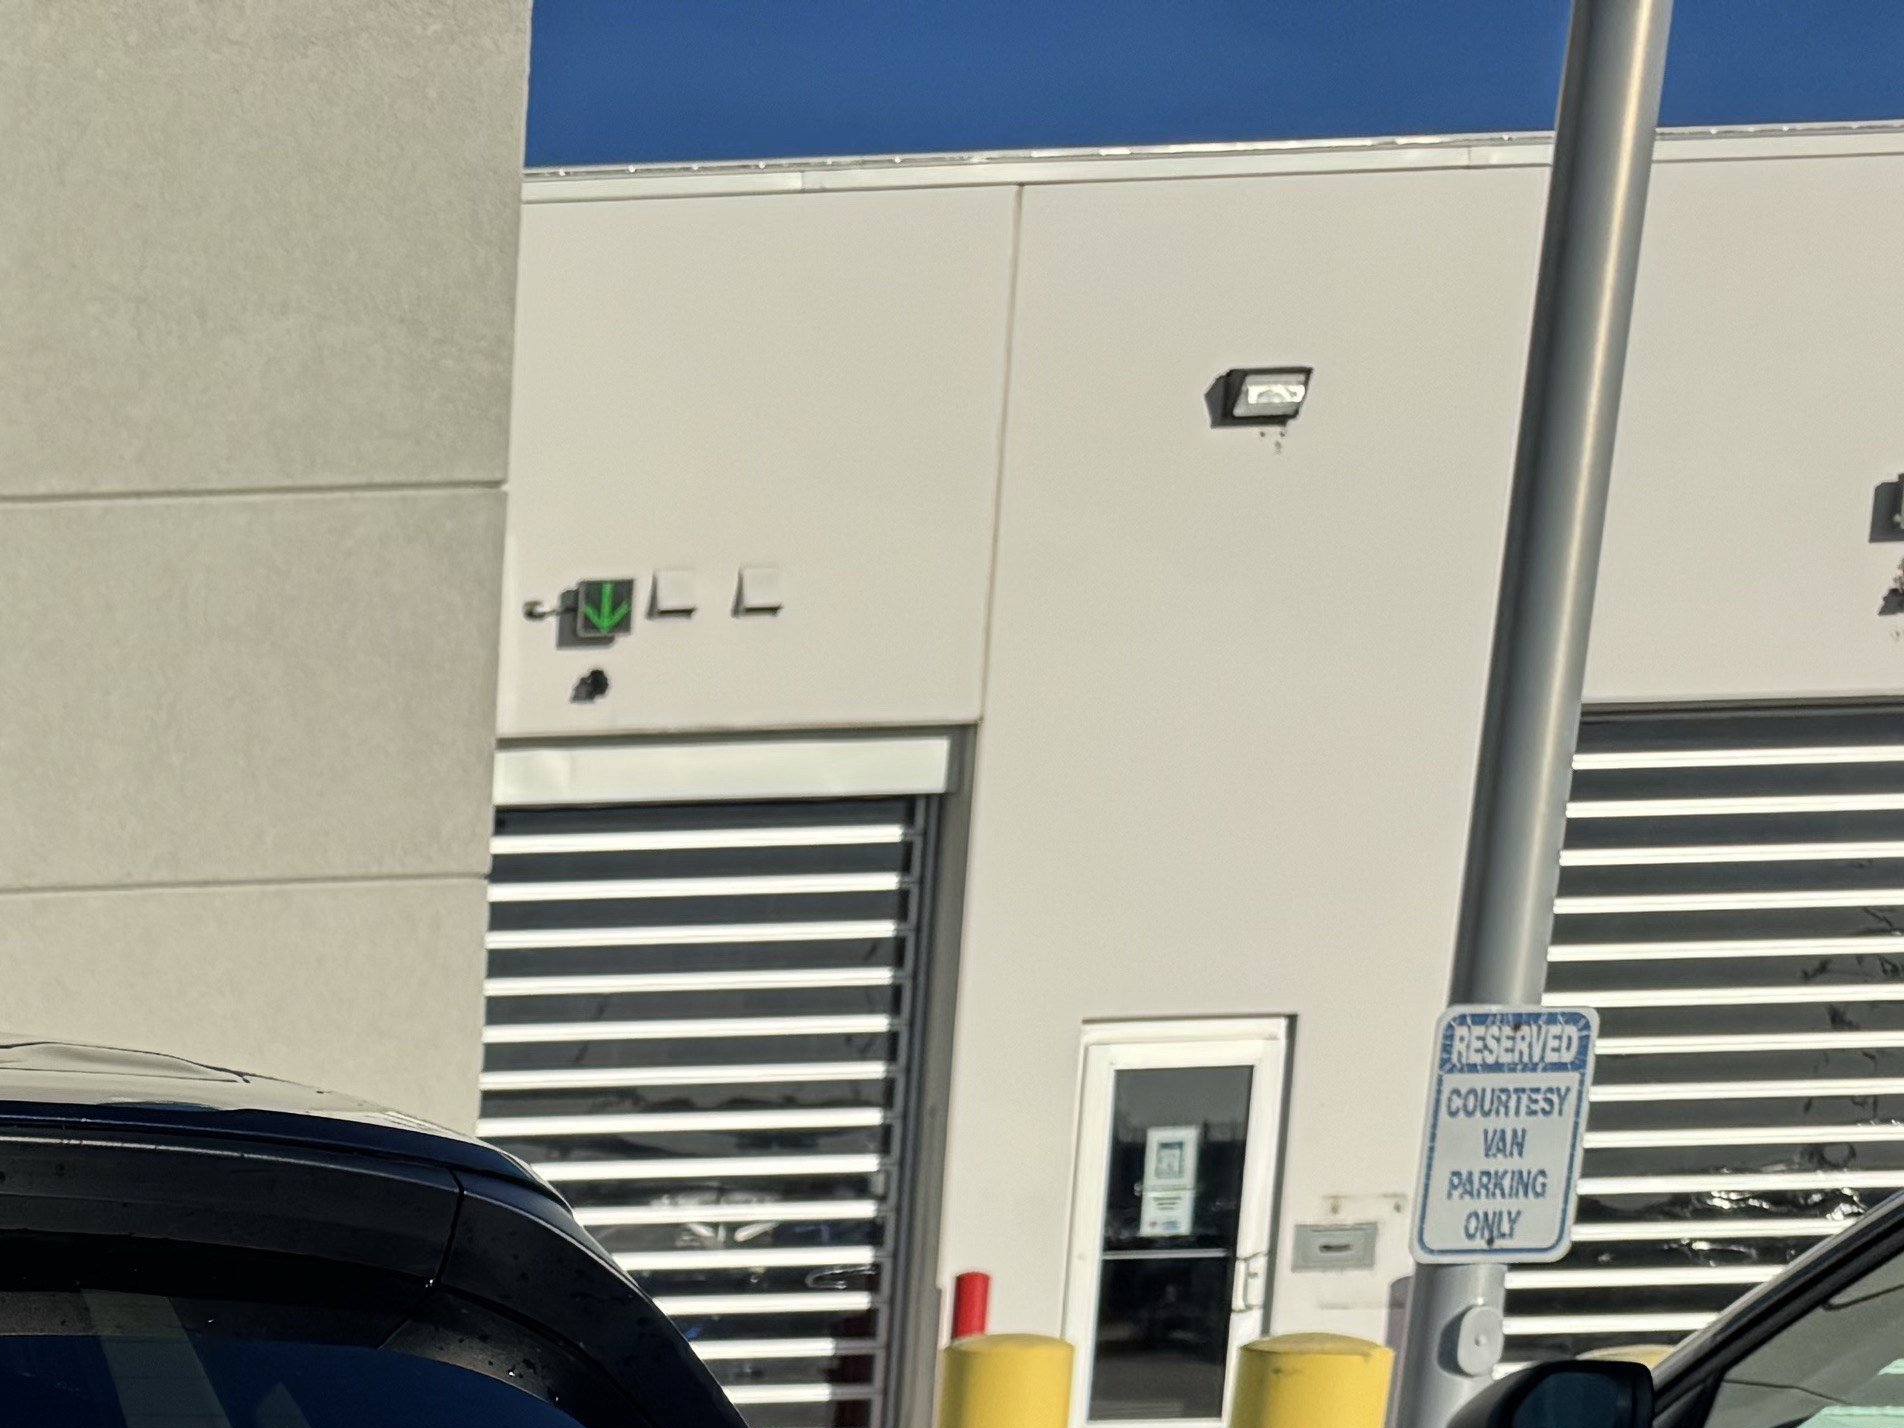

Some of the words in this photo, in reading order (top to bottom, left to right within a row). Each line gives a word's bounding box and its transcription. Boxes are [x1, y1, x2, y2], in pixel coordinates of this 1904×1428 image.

[1451, 1024, 1579, 1065] RESERVED
[1447, 1086, 1571, 1118] COURTESY
[1483, 1128, 1527, 1158] VAN
[1447, 1169, 1548, 1200] PARKING
[1463, 1210, 1522, 1240] ONLY
